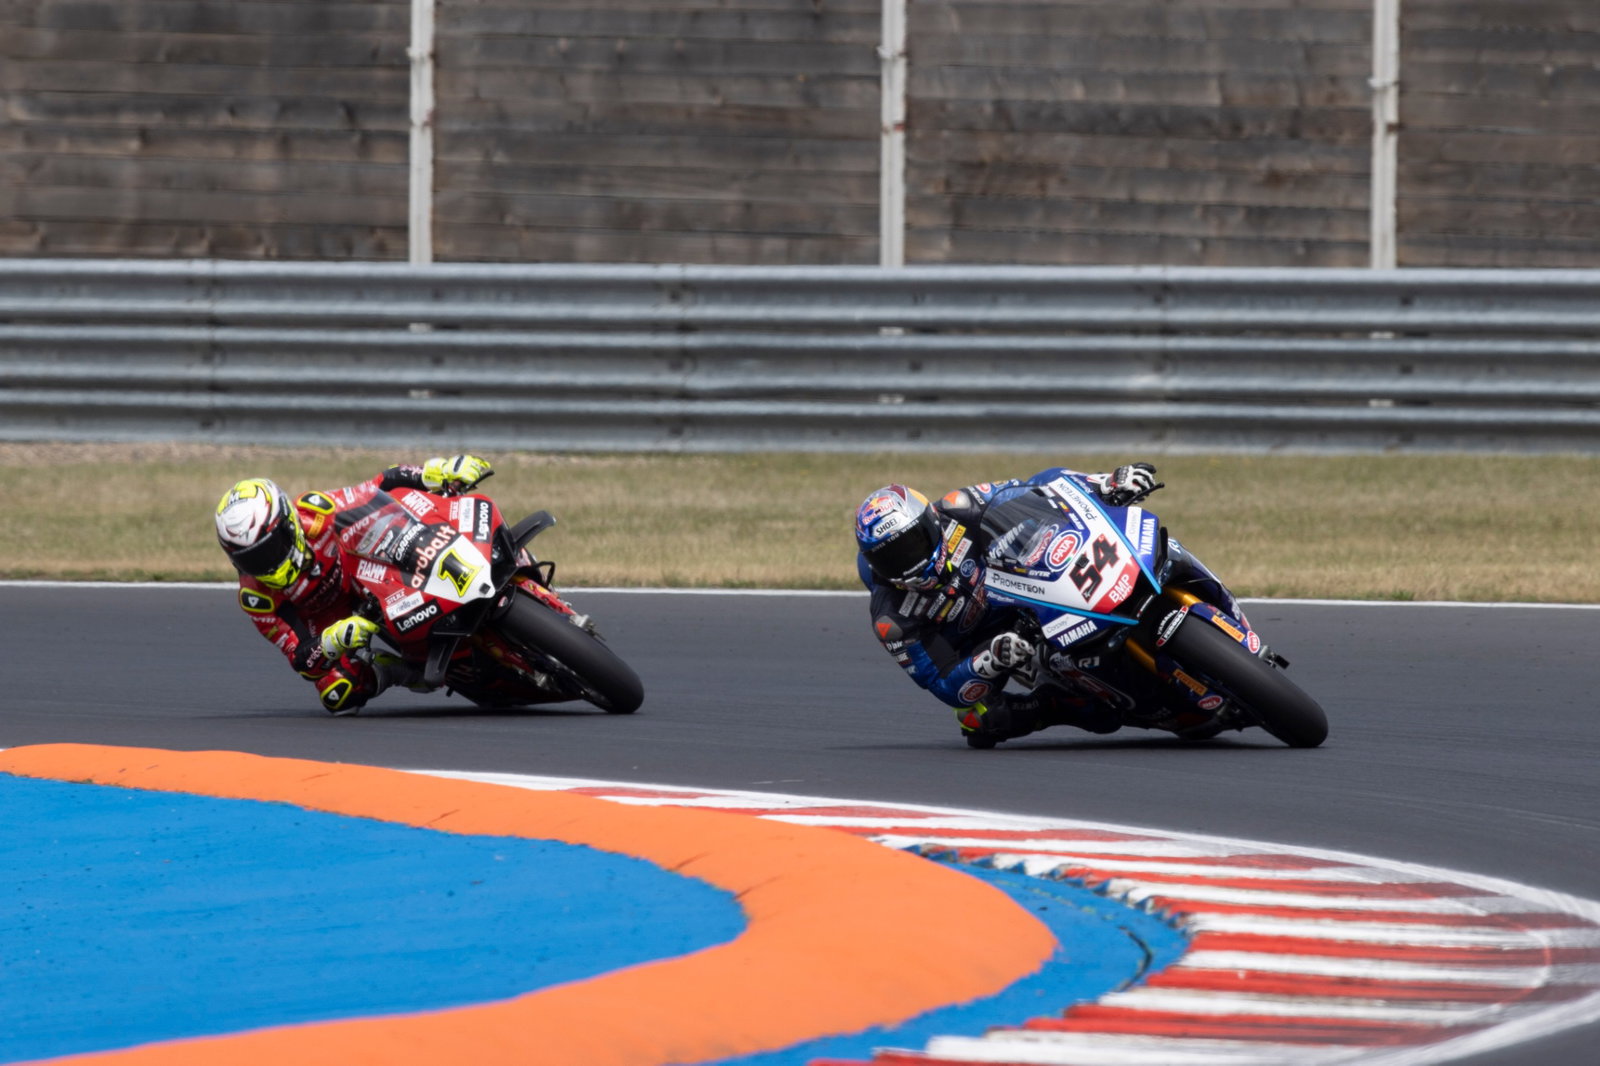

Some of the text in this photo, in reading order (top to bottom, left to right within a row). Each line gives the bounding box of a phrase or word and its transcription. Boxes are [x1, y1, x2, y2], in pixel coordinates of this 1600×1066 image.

[476, 502, 489, 540] Lenovo
[875, 518, 898, 536] SHOEI
[1053, 539, 1075, 563] PATA
[1140, 518, 1156, 555] YAMAHA
[357, 559, 388, 581] FIAMM
[411, 525, 457, 589] aruba.it
[1068, 533, 1120, 604] 54
[437, 547, 480, 598] 1
[991, 573, 1045, 595] PROMETEON
[1108, 574, 1130, 604] BMP
[396, 604, 437, 632] Lenovo
[1057, 620, 1098, 647] YAMAHA
